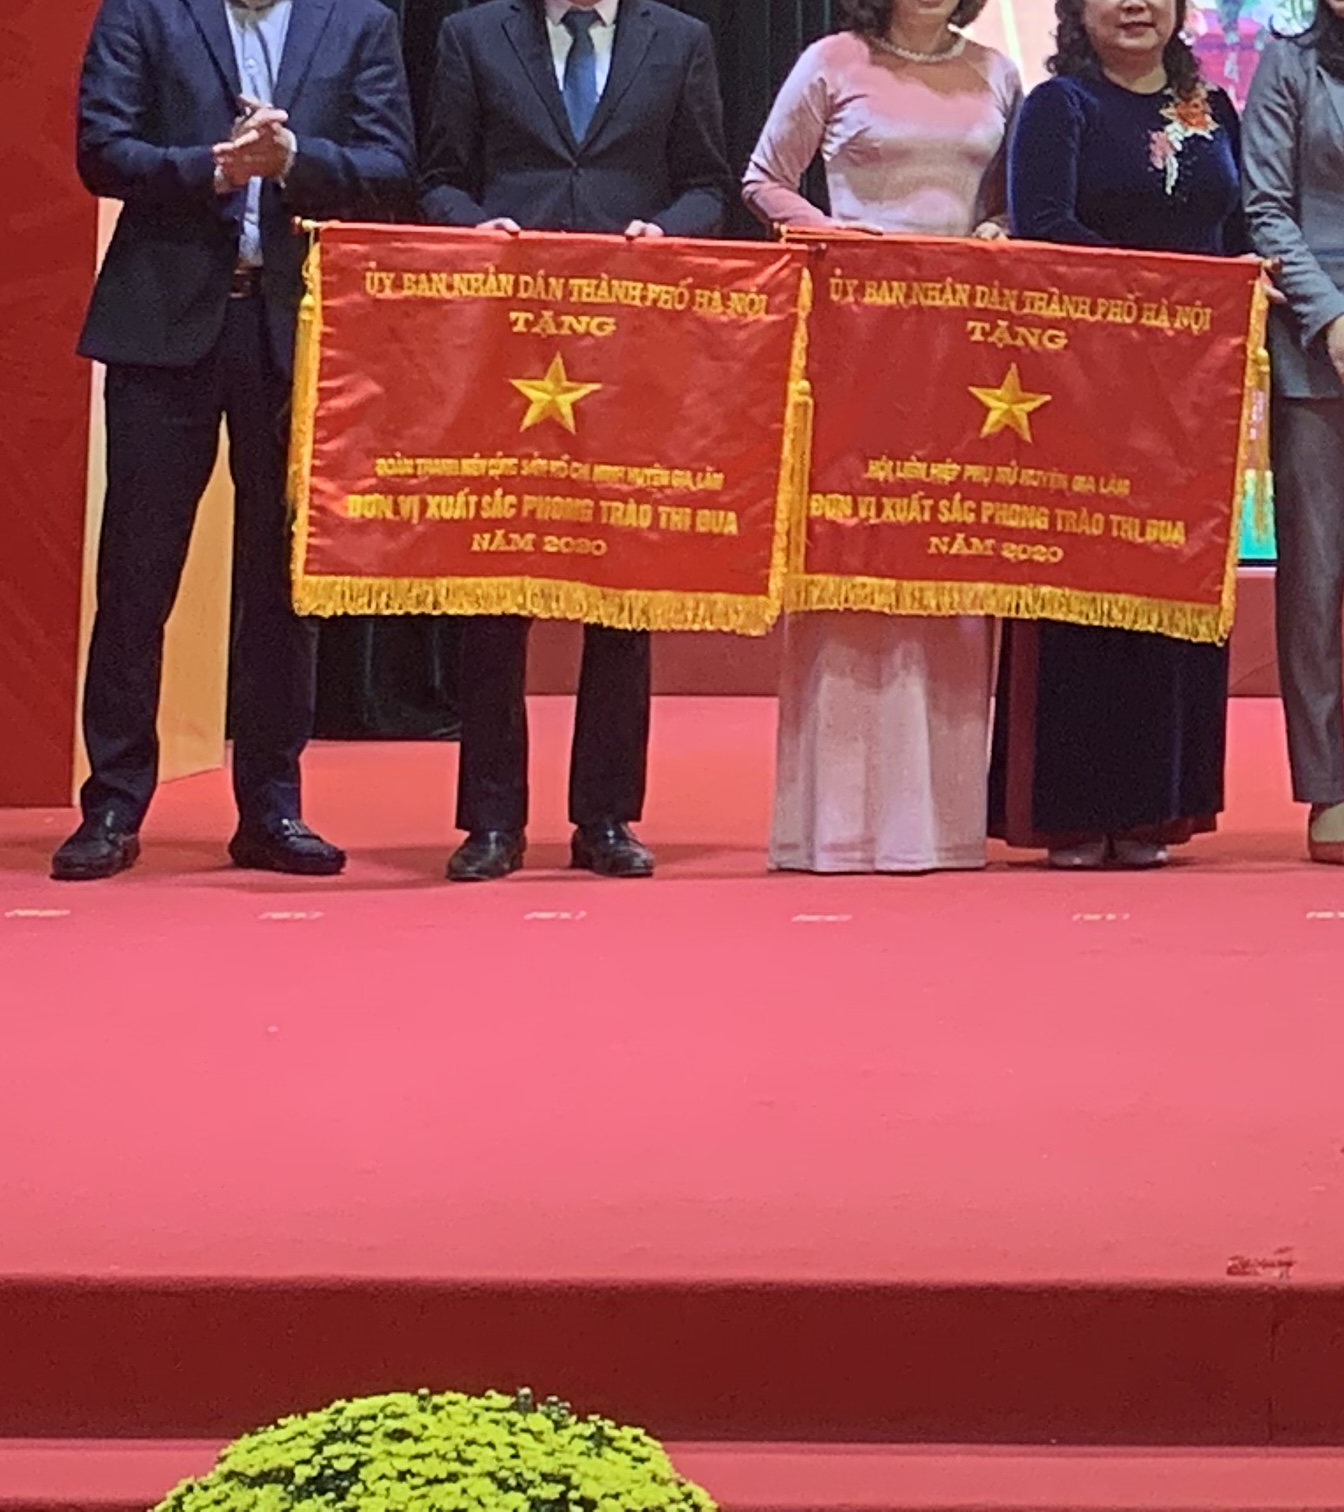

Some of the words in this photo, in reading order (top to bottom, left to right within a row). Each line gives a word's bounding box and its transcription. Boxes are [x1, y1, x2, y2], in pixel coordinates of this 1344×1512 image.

[509, 310, 616, 338] TẶNG
[967, 319, 1068, 350] TẶNG
[471, 529, 536, 553] NĂM
[543, 535, 608, 557] 2020
[928, 533, 996, 555] NĂM
[1001, 541, 1064, 563] 2020
